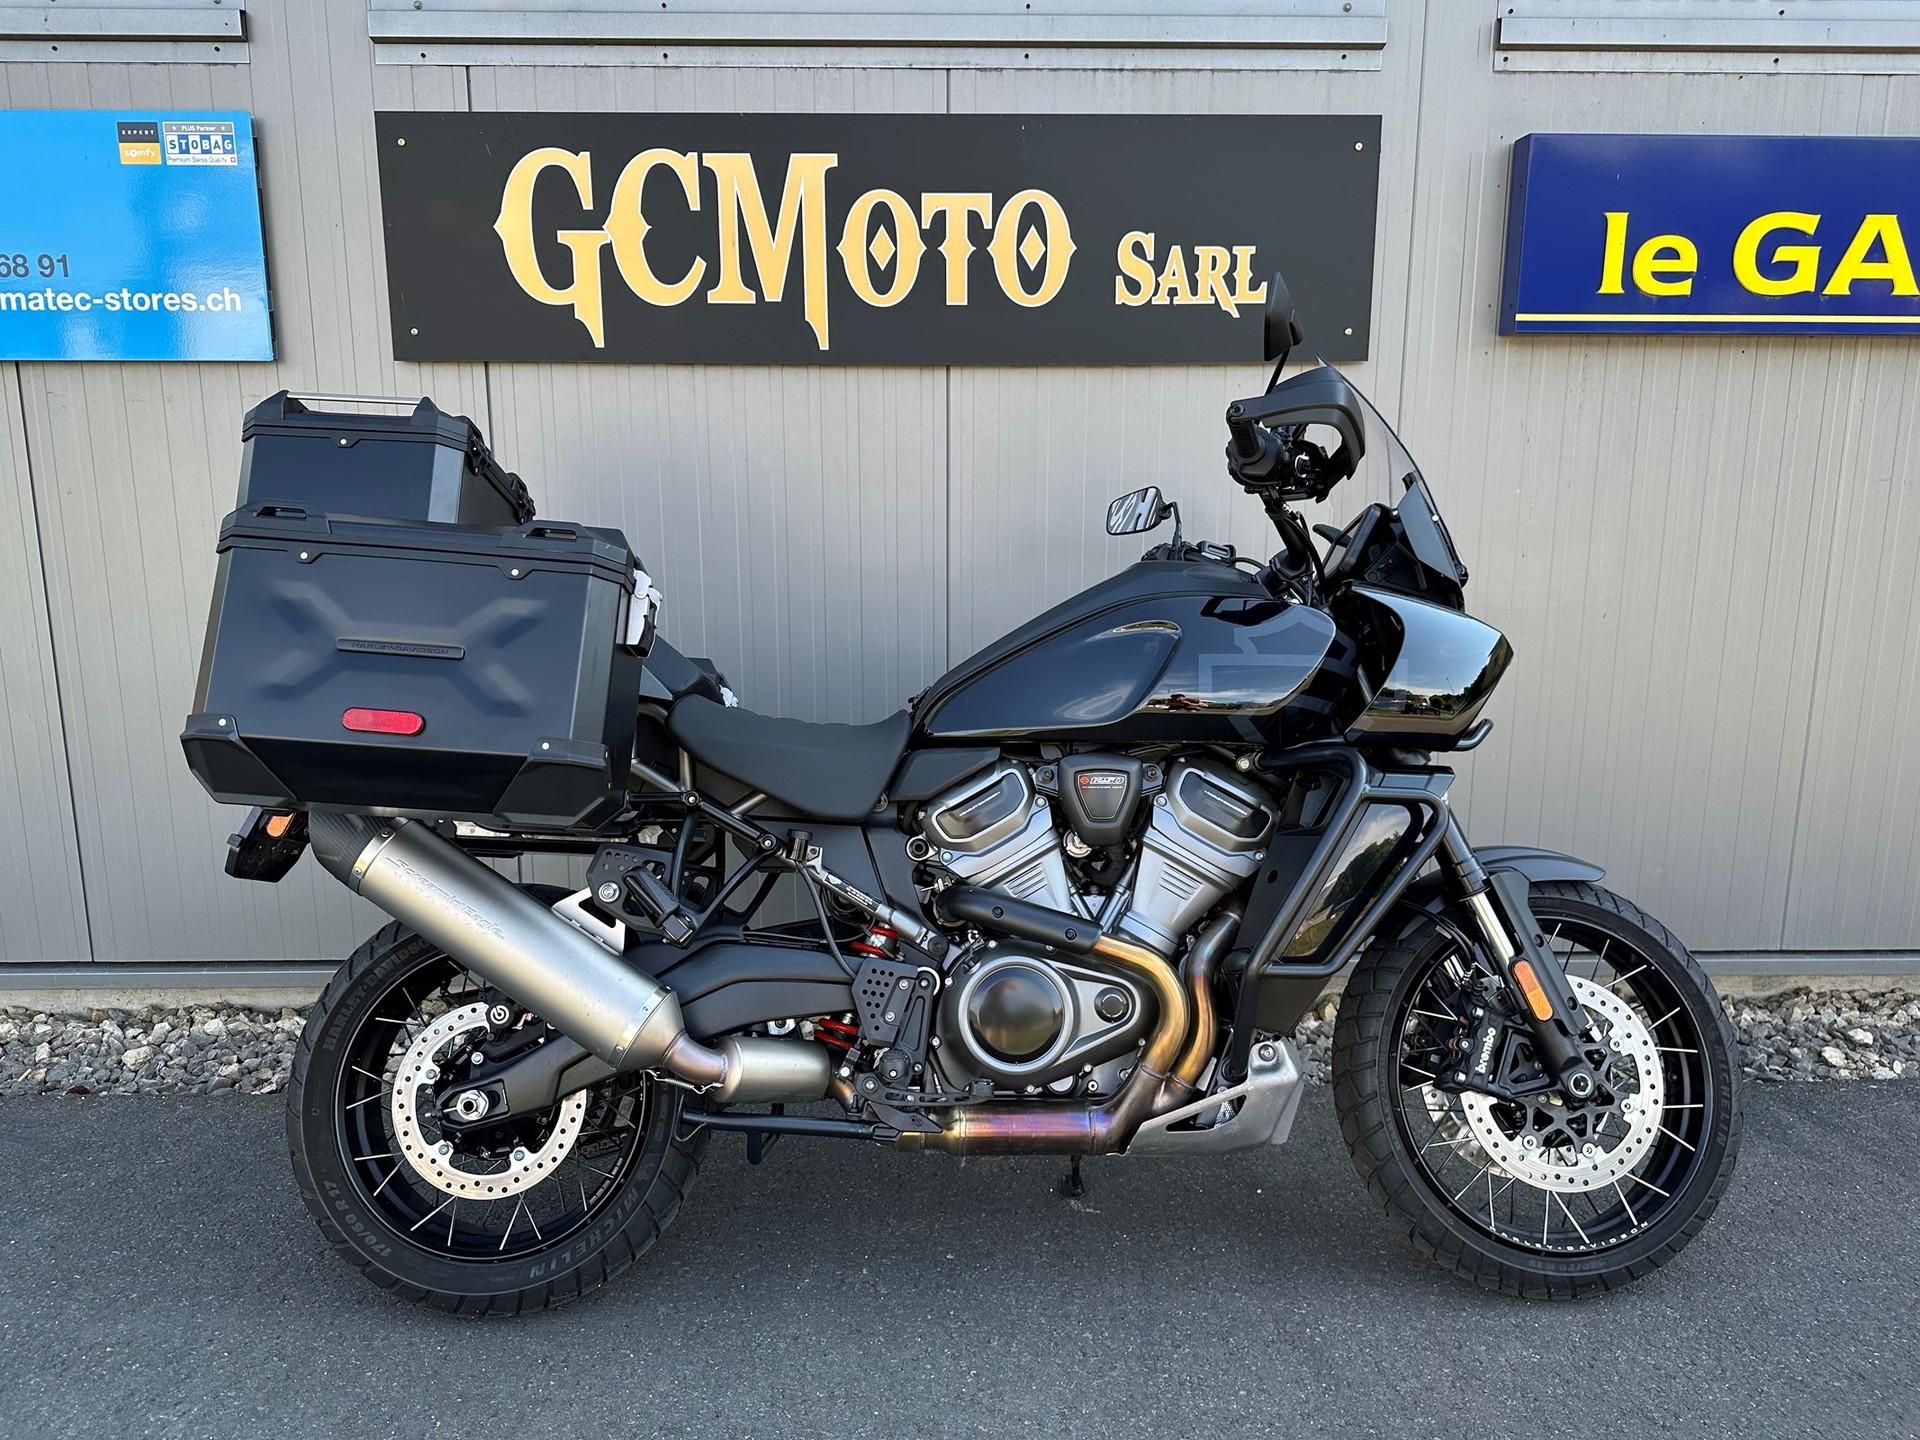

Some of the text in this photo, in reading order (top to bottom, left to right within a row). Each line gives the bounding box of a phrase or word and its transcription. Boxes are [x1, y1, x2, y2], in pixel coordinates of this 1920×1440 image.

[181, 123, 216, 131] PLUS Partner
[169, 139, 232, 151] STOBAG
[209, 156, 228, 165] Quality
[0, 253, 70, 278] 68 91
[1597, 211, 1920, 297] le GA
[0, 288, 242, 312] matec-stores.ch
[352, 641, 450, 656] HARLEY-DAVIDSON
[323, 939, 430, 1051] HARLEY-DAVIDSO
[1474, 1027, 1496, 1074] brembo
[1714, 1044, 1731, 1148] MICHELIN
[323, 1180, 392, 1258] 170/60 R 17
[529, 1187, 640, 1280] MICHELIN
[1489, 1220, 1650, 1251] HARLEY-DAVIDSON
